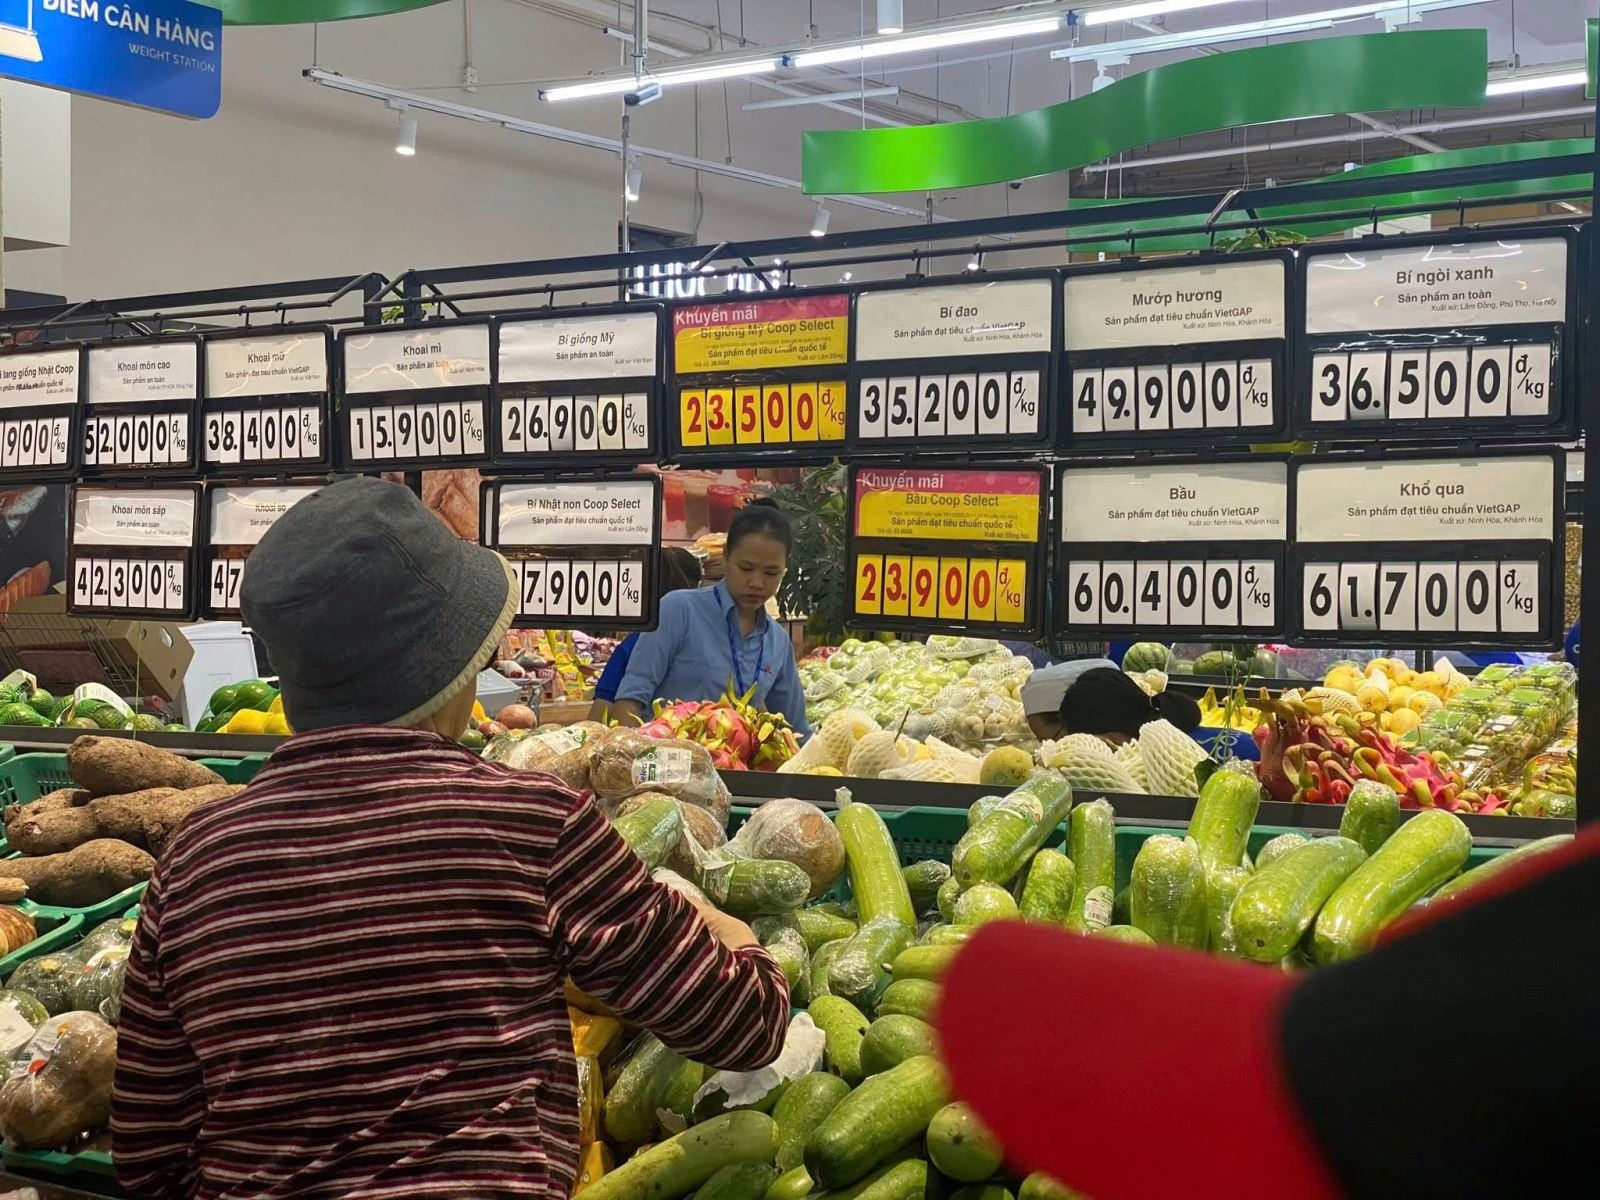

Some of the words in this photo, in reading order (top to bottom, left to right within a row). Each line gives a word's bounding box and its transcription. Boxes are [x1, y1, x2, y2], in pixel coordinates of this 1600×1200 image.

[105, 4, 148, 35] CÂN
[156, 17, 215, 52] HÀNG
[129, 42, 170, 62] WEIGHT
[173, 54, 215, 73] STATION
[1397, 270, 1412, 284] Bí
[1416, 268, 1450, 286] ngòi
[1455, 266, 1493, 281] xanh
[1132, 294, 1172, 306] Mướp
[1177, 289, 1222, 303] hương
[1398, 292, 1417, 304] Sản
[1420, 290, 1449, 304] phẩm
[1452, 292, 1465, 300] an
[1468, 289, 1492, 300] toàn
[675, 306, 728, 327] Khuyến
[732, 306, 758, 320] mãi
[940, 306, 952, 319] Bí
[956, 306, 978, 318] đao
[1105, 316, 1121, 326] Sản
[1123, 313, 1147, 326] phẩm
[1150, 313, 1164, 324] đạt
[1166, 312, 1183, 321] tiêu
[1185, 309, 1213, 320] chuẩn
[1214, 307, 1252, 317] VietGAP
[767, 323, 796, 336] Coop
[799, 320, 834, 332] Select
[894, 329, 908, 338] Sản
[910, 326, 932, 339] phẩm
[934, 326, 947, 337] đạt
[949, 326, 963, 335] tiêu
[558, 335, 569, 345] Bí
[570, 332, 598, 347] giống
[600, 332, 614, 344] Mỹ
[248, 352, 270, 363] Khoai
[403, 345, 428, 356] Khoai
[430, 343, 441, 353] mì
[556, 352, 568, 360] Sản
[570, 350, 588, 360] phẩm
[3, 370, 17, 380] lang
[18, 367, 37, 380] giống
[38, 366, 54, 377] Nhật
[55, 365, 74, 374] Coop
[118, 361, 138, 371] Khoai
[140, 360, 156, 370] môn
[157, 362, 171, 370] cao
[1320, 358, 1500, 410] 36.500
[864, 378, 1000, 425] 35.200
[1078, 368, 1231, 419] 49.900
[508, 402, 617, 440] 26.900
[687, 391, 813, 433] 23.500
[85, 420, 166, 455] 52.000
[209, 415, 296, 451] 38.400
[357, 410, 456, 448] 15.900
[862, 470, 913, 489] Khuyến
[918, 474, 944, 488] mãi
[1170, 485, 1196, 500] Bầu
[1400, 480, 1430, 497] Khổ
[1435, 484, 1464, 498] qua
[527, 499, 537, 509] Bí
[539, 499, 561, 512] Nhật
[563, 501, 581, 509] non
[584, 499, 608, 511] Coop
[610, 498, 640, 509] Select
[930, 494, 960, 508] Coop
[964, 495, 999, 506] Select
[1348, 506, 1367, 516] Sản
[1370, 504, 1397, 518] phẩm
[1400, 505, 1417, 517] đạt
[1419, 505, 1439, 515] tiêu
[1442, 502, 1474, 514] chuẩn
[1476, 504, 1520, 514] VietGAP
[112, 505, 132, 514] Khoai
[135, 505, 151, 514] môn
[152, 505, 166, 516] sáp
[1108, 510, 1125, 519] Sản
[1128, 508, 1152, 520] phẩm
[1154, 509, 1170, 520] đạt
[1171, 508, 1188, 517] tiêu
[1190, 506, 1219, 517] chuẩn
[1221, 507, 1259, 517] VietGAP
[891, 517, 905, 525] Sản
[907, 516, 928, 528] phẩm
[929, 519, 941, 528] đạt
[943, 519, 957, 527] tiêu
[959, 518, 982, 528] chuẩn
[984, 520, 1003, 530] quốc
[1005, 520, 1012, 528] tế
[77, 564, 161, 597] 42.300
[512, 568, 612, 606] 7.900
[861, 562, 990, 608] 23.900
[1075, 566, 1232, 613] 60.400
[1310, 570, 1489, 617] 61.700
